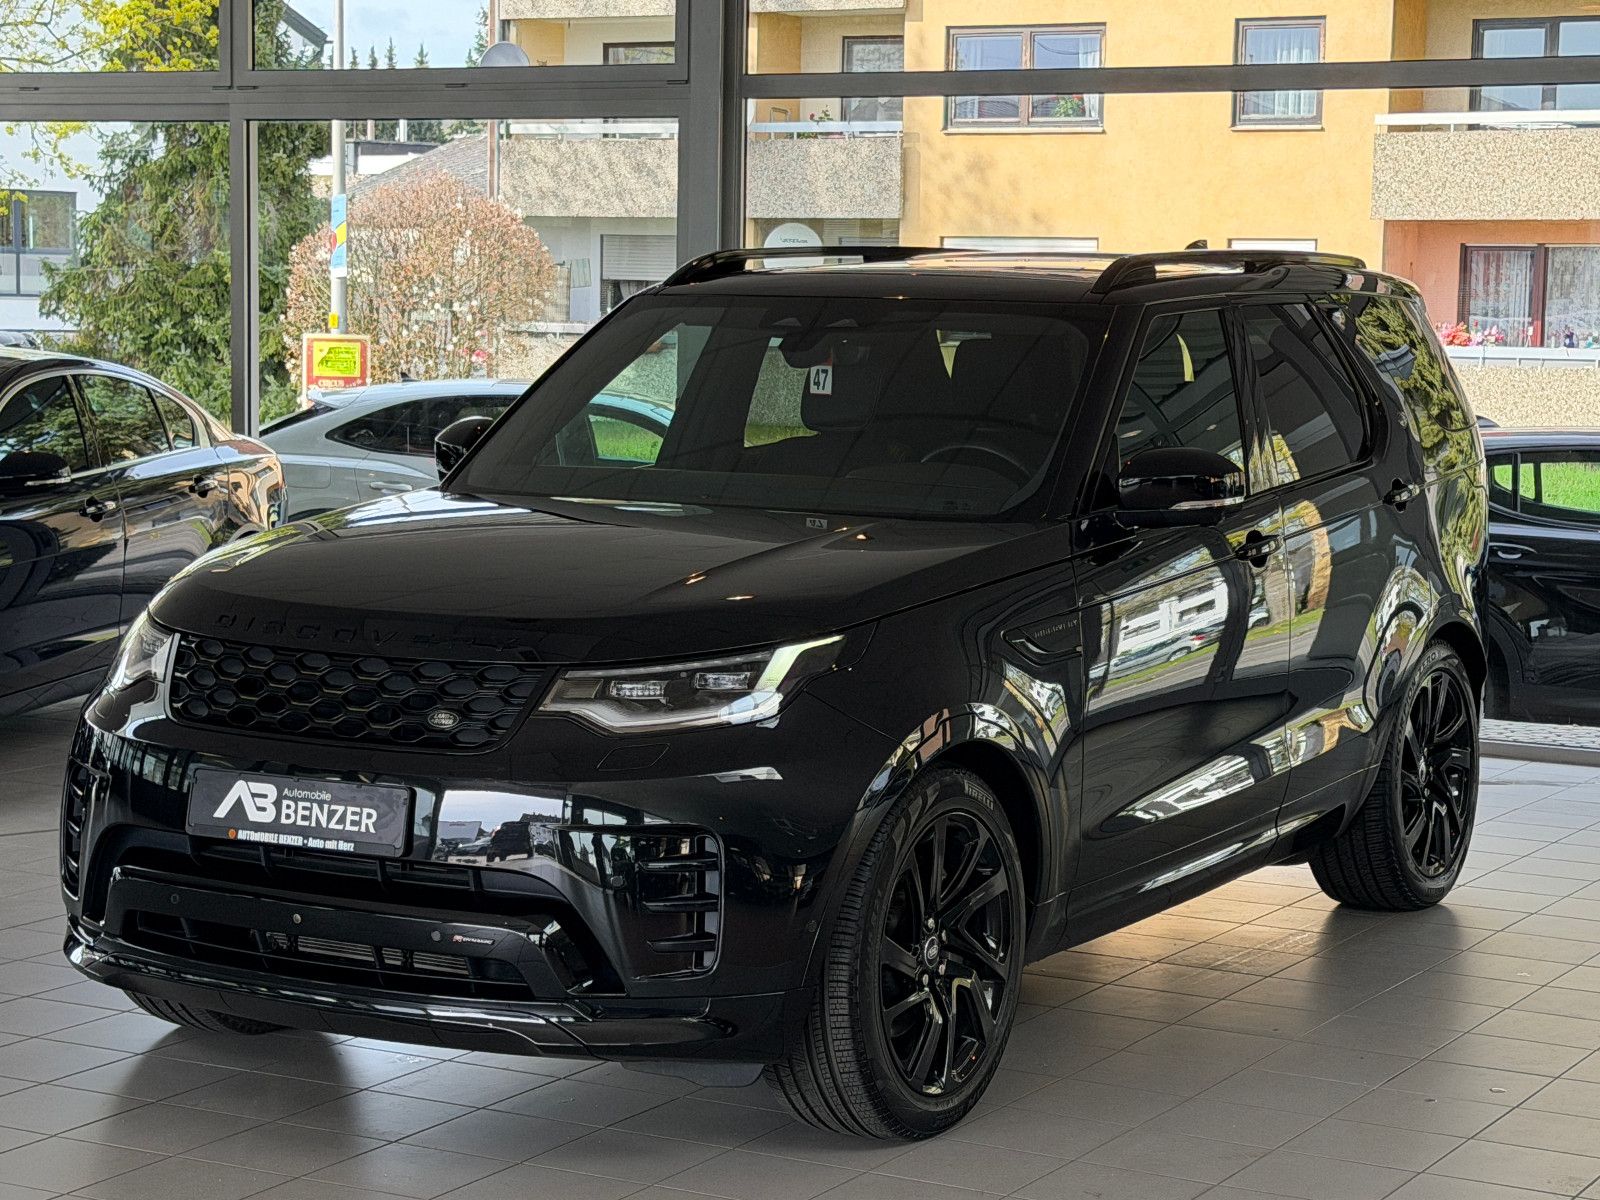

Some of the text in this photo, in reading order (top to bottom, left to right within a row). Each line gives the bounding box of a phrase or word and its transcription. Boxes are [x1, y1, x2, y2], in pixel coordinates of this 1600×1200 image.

[813, 368, 829, 391] 47
[282, 787, 332, 802] Automobile
[280, 800, 378, 834] BENZER
[279, 833, 304, 847] BENZER
[307, 837, 325, 849] Auto
[338, 840, 355, 852] Herz
